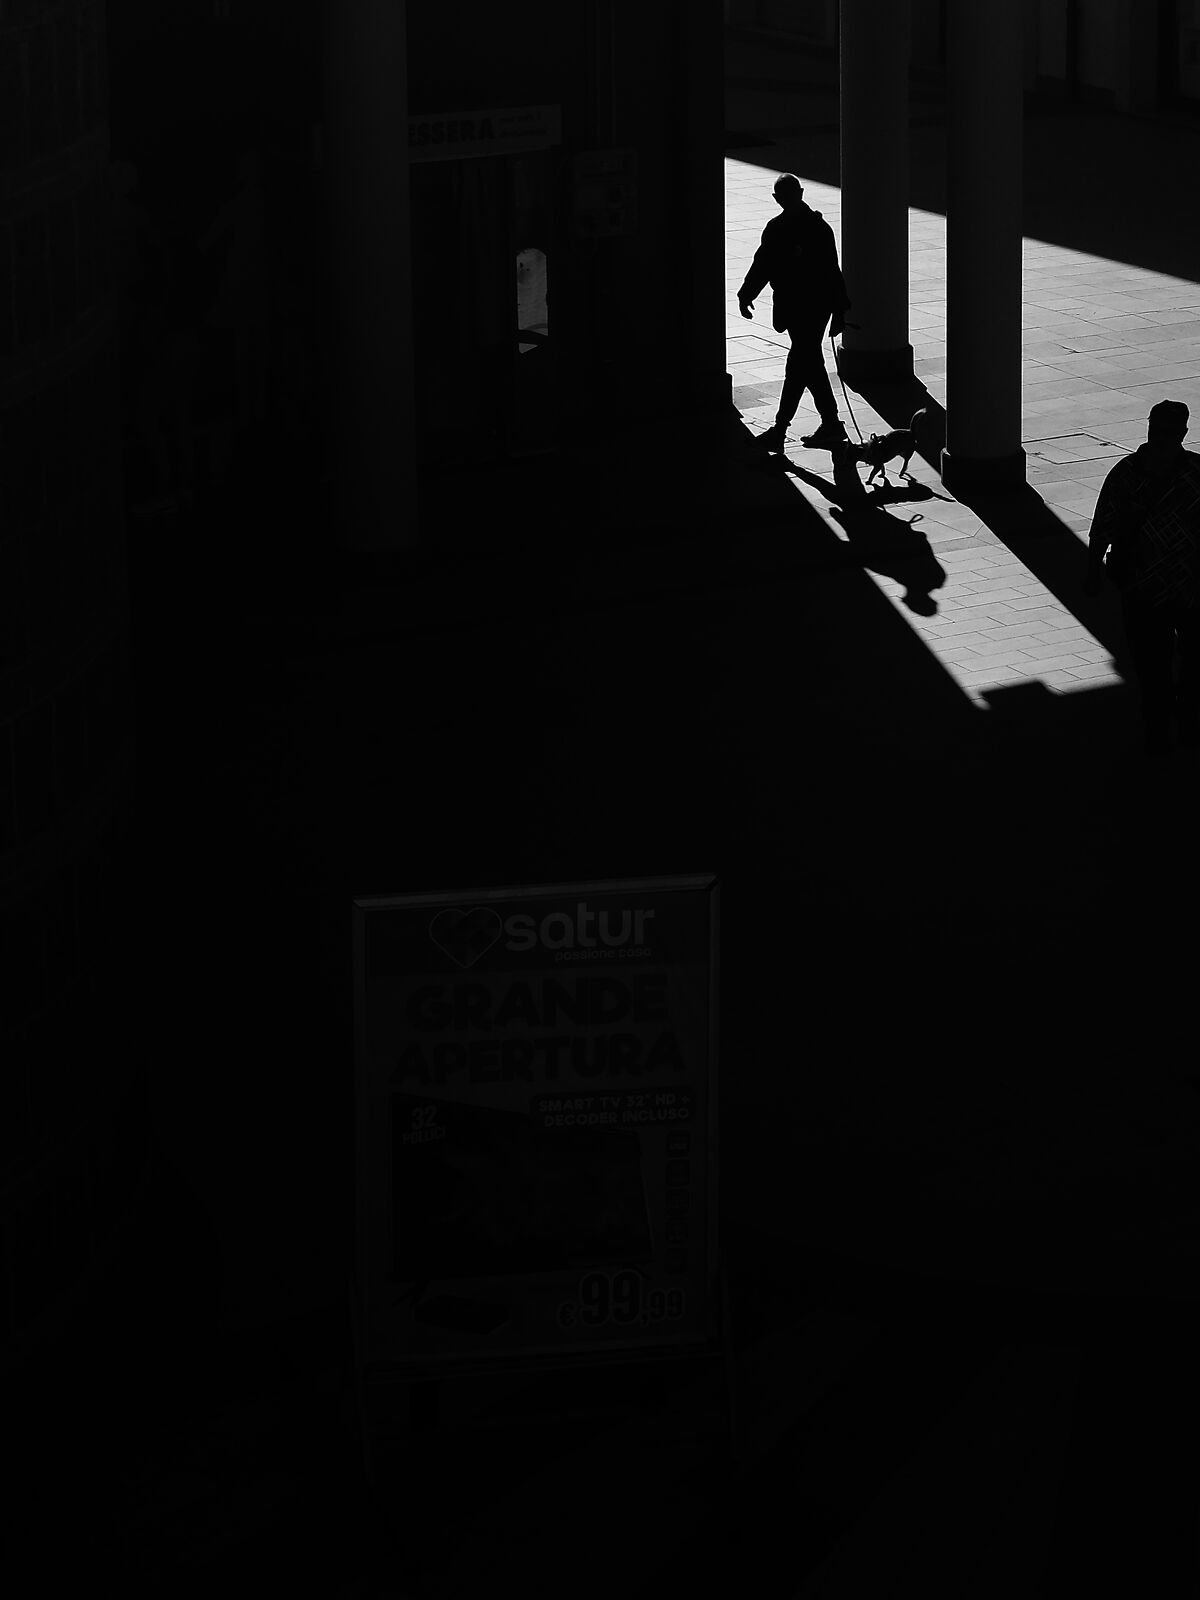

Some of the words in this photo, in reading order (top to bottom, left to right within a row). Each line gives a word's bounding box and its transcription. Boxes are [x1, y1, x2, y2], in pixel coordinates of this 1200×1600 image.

[504, 901, 656, 952] satur
[406, 973, 669, 1032] GRANDE
[389, 1031, 686, 1086] APERTURA
[411, 1105, 438, 1130] 32
[538, 1097, 595, 1113] SMART
[600, 1095, 621, 1110] TV
[655, 1093, 676, 1106] HD
[544, 1111, 619, 1128] DECODER
[622, 1107, 689, 1123] INCLUSO
[556, 1269, 687, 1328] €99,99
